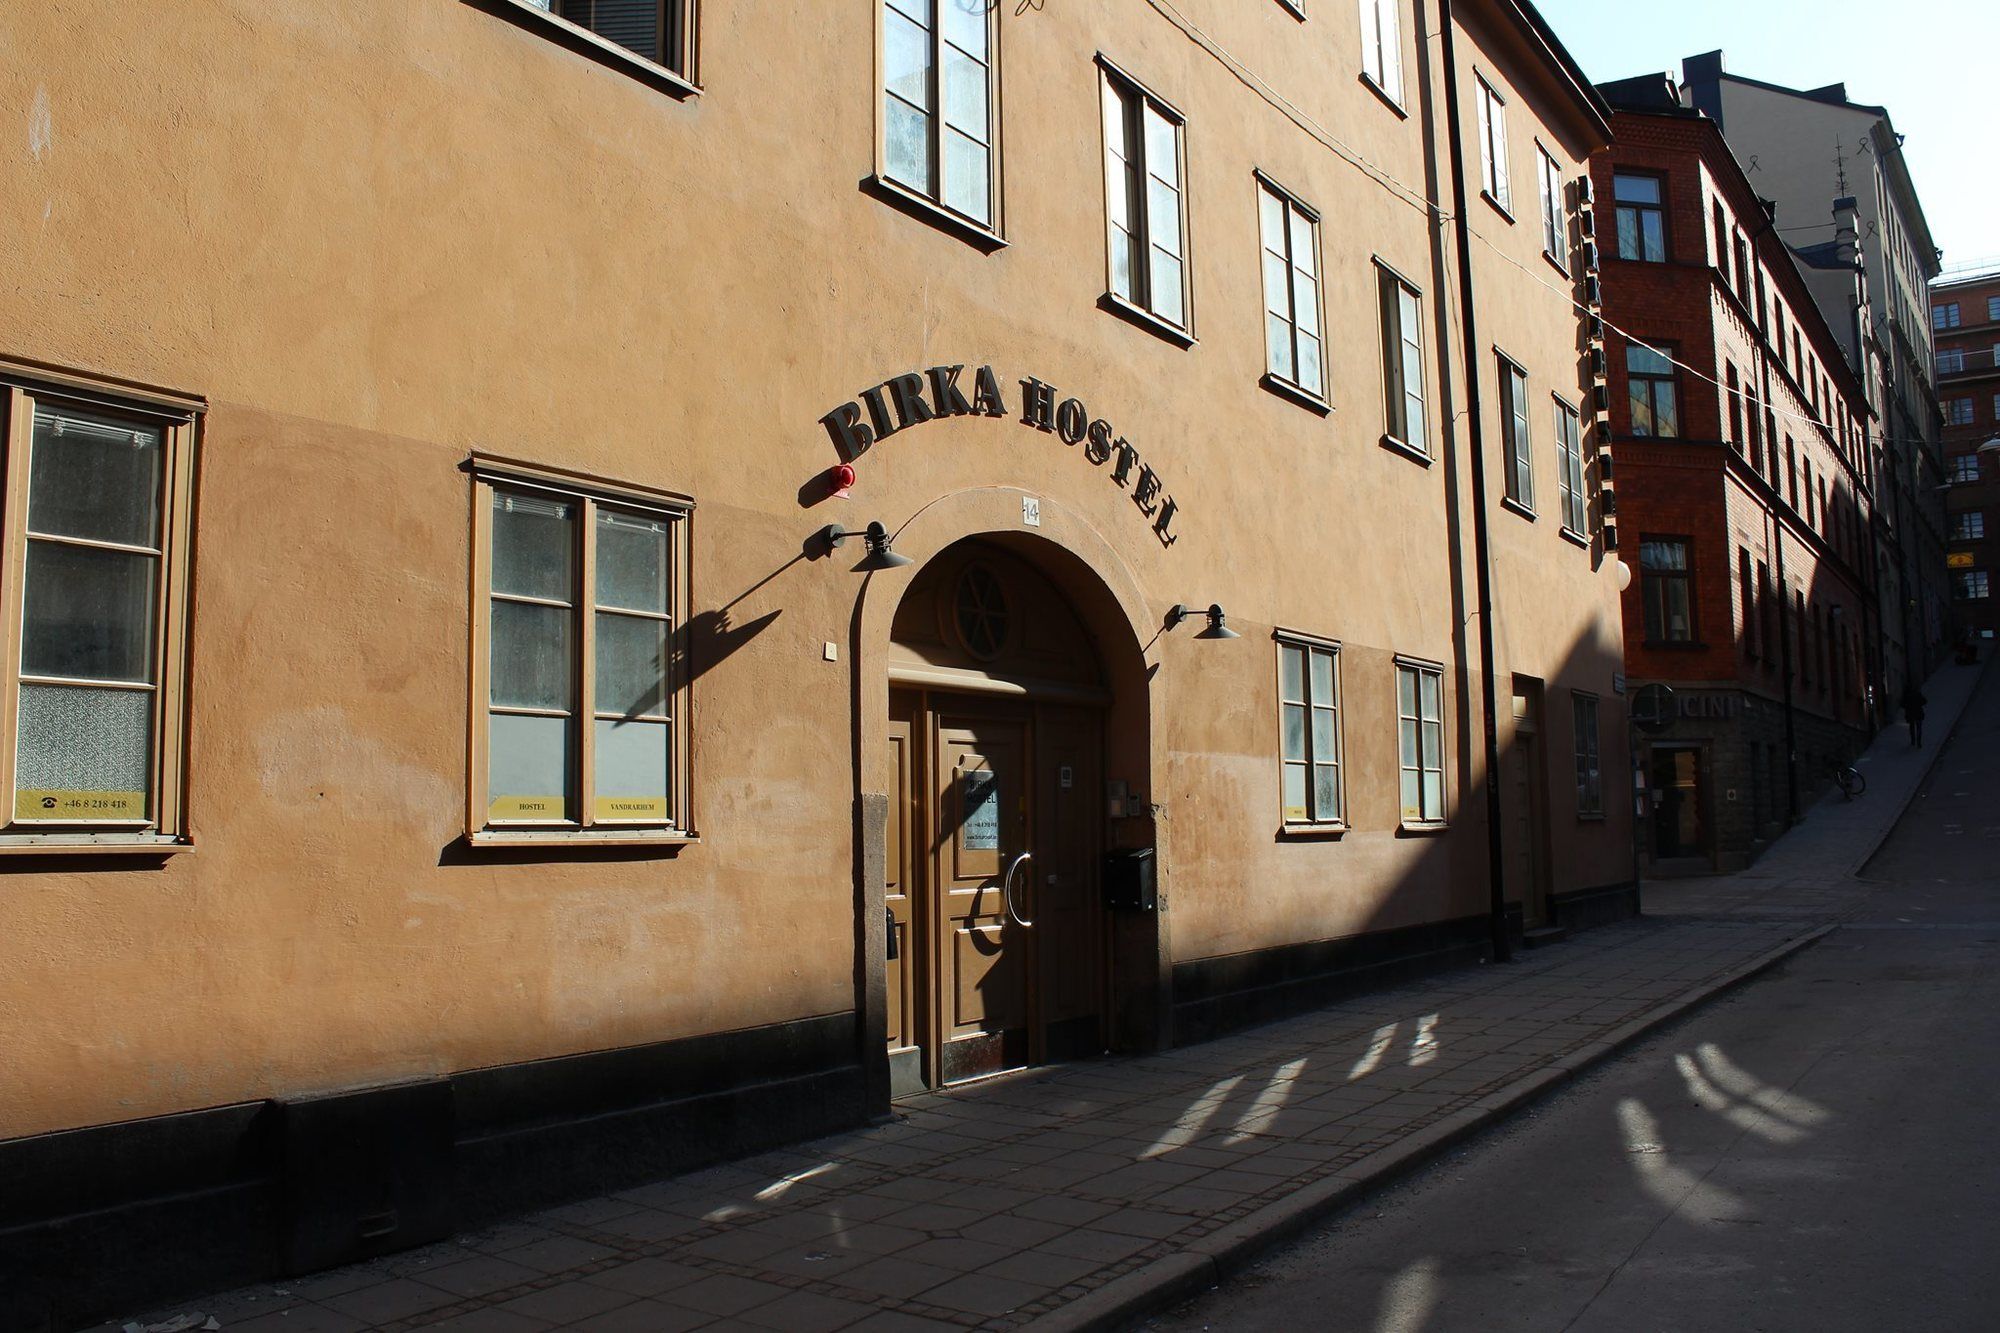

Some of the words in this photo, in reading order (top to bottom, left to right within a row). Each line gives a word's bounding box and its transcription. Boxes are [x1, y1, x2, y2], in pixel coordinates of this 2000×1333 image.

[817, 364, 1008, 465] BIRKA
[1017, 374, 1179, 550] HOSTEL
[1024, 502, 1038, 521] 14
[64, 799, 81, 808] +46
[92, 799, 109, 808] 218
[111, 799, 127, 808] 418
